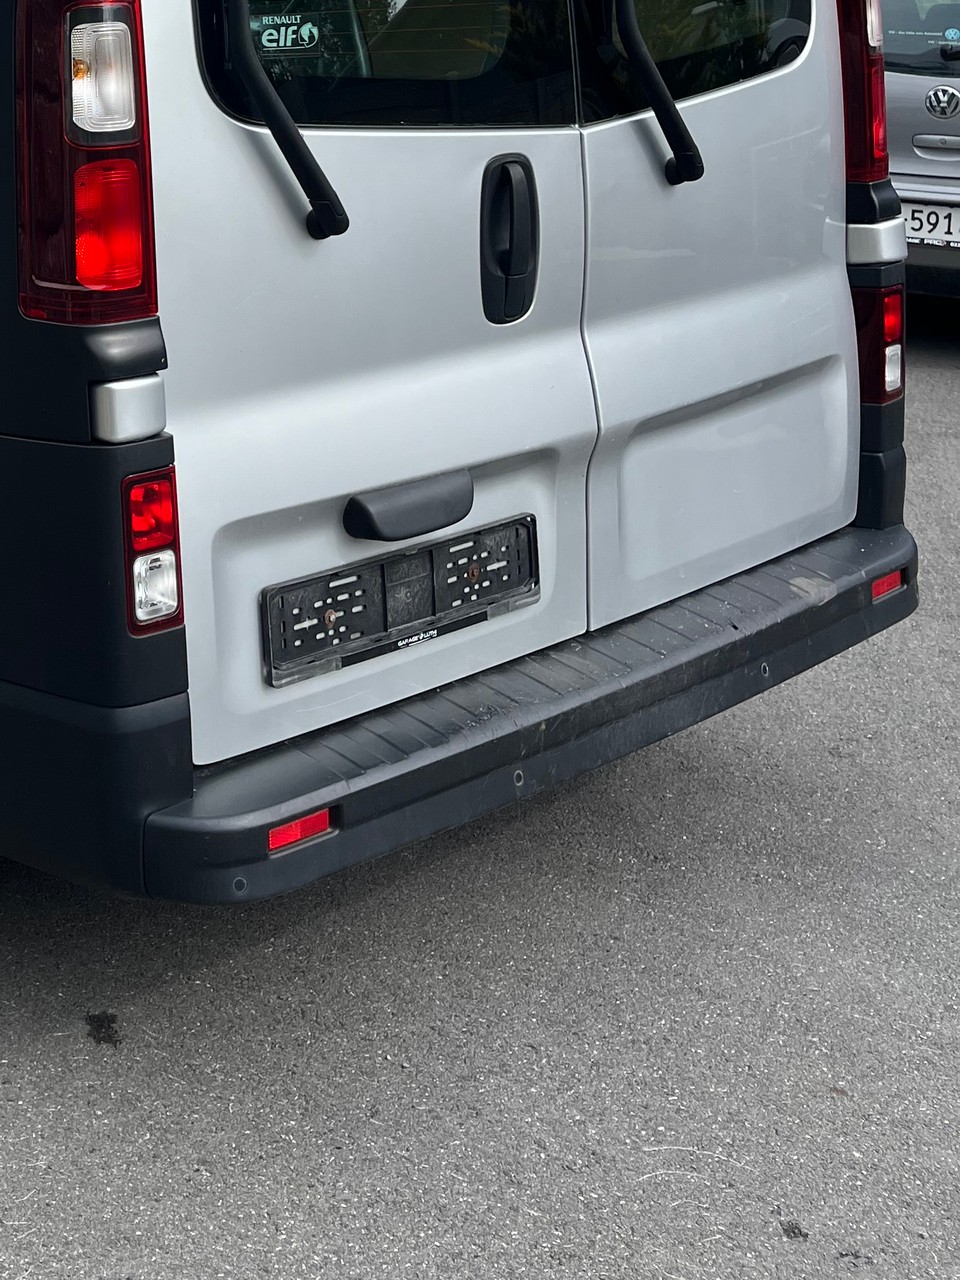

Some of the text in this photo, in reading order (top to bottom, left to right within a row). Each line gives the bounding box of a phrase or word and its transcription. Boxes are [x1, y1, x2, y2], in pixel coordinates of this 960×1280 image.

[262, 15, 302, 25] RENAULT
[261, 26, 298, 47] elf
[910, 209, 960, 236] 591
